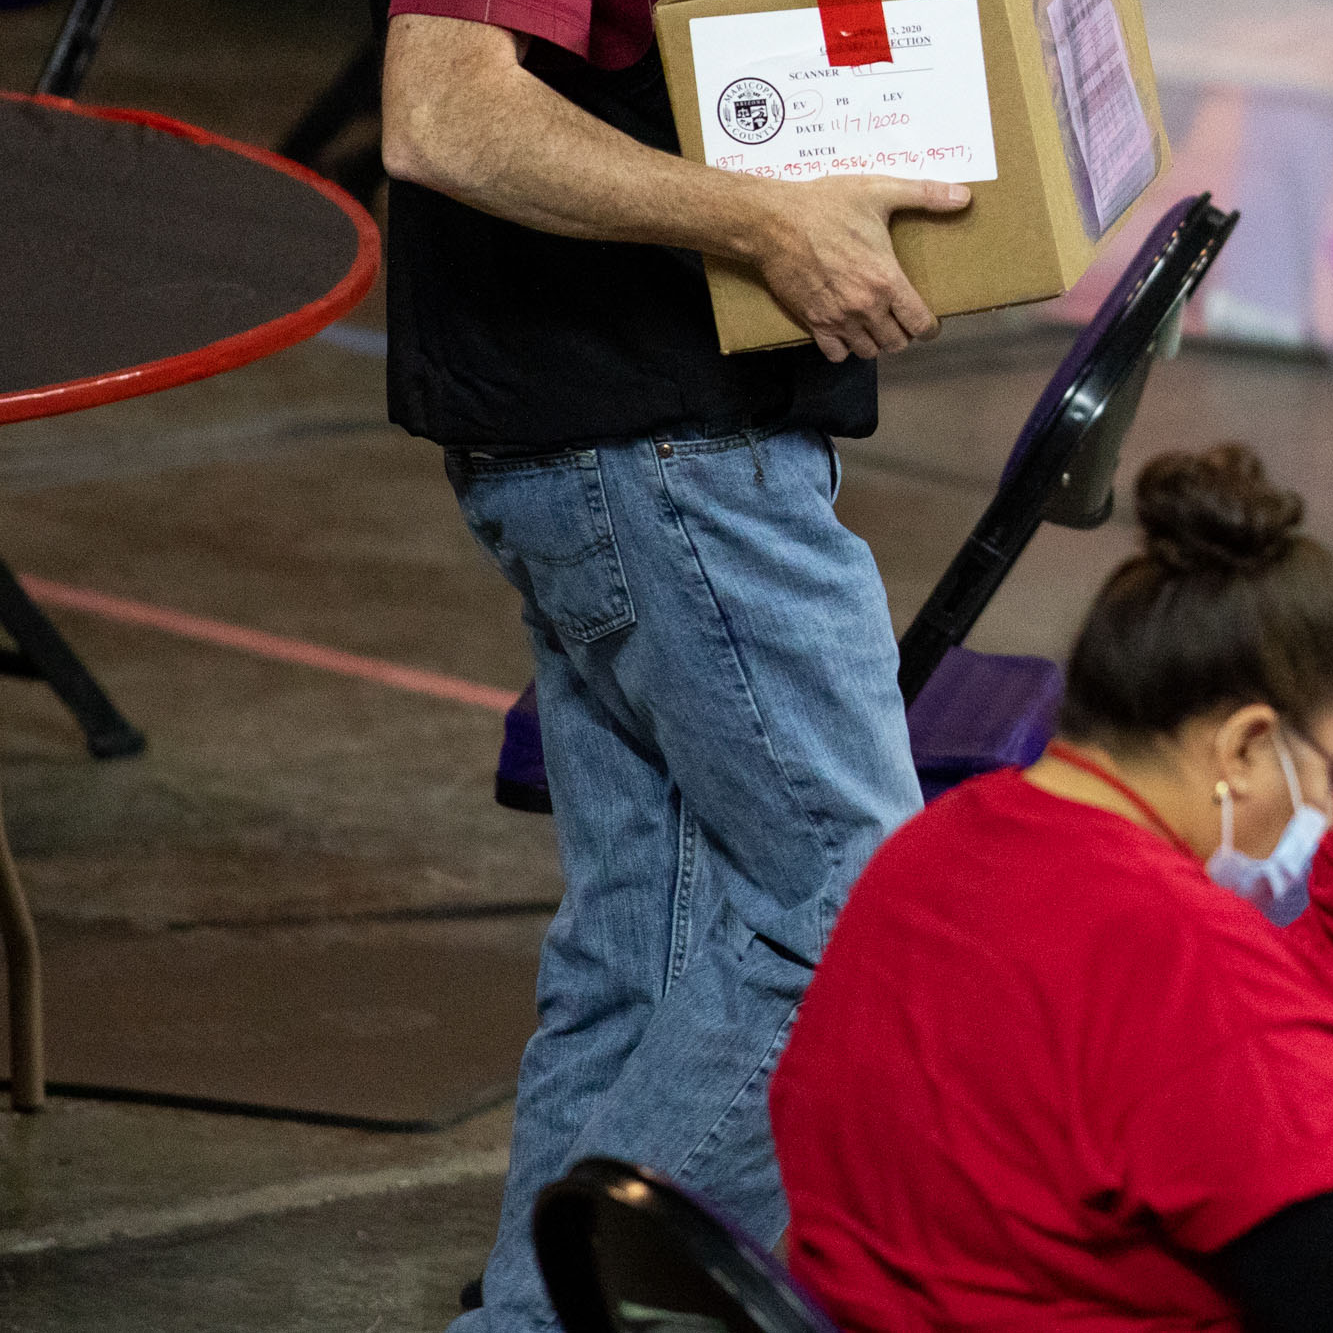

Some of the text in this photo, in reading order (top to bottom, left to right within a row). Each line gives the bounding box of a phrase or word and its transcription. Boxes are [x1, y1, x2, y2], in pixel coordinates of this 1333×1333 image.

[891, 27, 899, 35] 3,
[901, 24, 922, 34] 2020
[880, 36, 931, 48] ECTION
[789, 68, 839, 81] SCANNER
[724, 81, 773, 103] MARICOPA
[883, 92, 904, 103] LEV
[793, 100, 807, 111] EV
[836, 97, 849, 107] PB
[732, 123, 775, 141] COUNTY
[796, 123, 825, 135] DATE
[799, 146, 836, 158] BATCH
